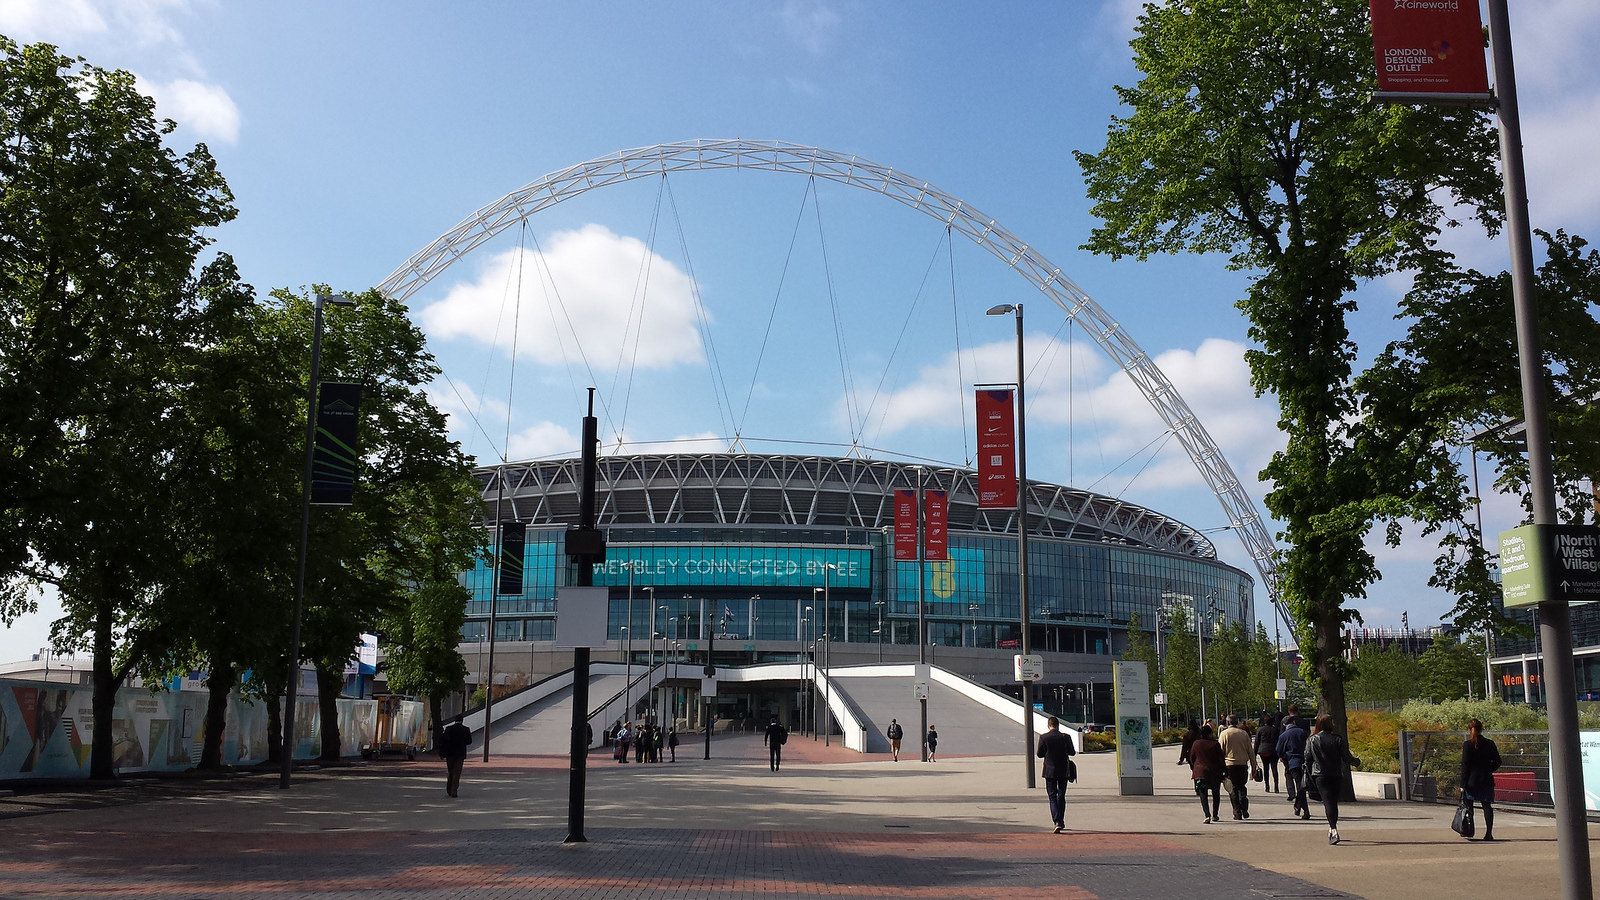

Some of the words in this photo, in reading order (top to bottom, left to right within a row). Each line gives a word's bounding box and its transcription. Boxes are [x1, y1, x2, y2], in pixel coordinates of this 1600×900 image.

[1406, 0, 1459, 10] cineworld
[1384, 48, 1427, 57] LONDON
[1385, 56, 1434, 64] DESIGNER
[1385, 64, 1422, 72] OUTLET
[1560, 534, 1597, 546] North
[1511, 545, 1521, 554] and
[1561, 546, 1595, 558] West
[1503, 554, 1525, 564] bedroom
[593, 558, 680, 576] WEMBLEY
[684, 559, 798, 576] CONNECTED
[806, 560, 828, 576] BY
[836, 561, 858, 577] EE
